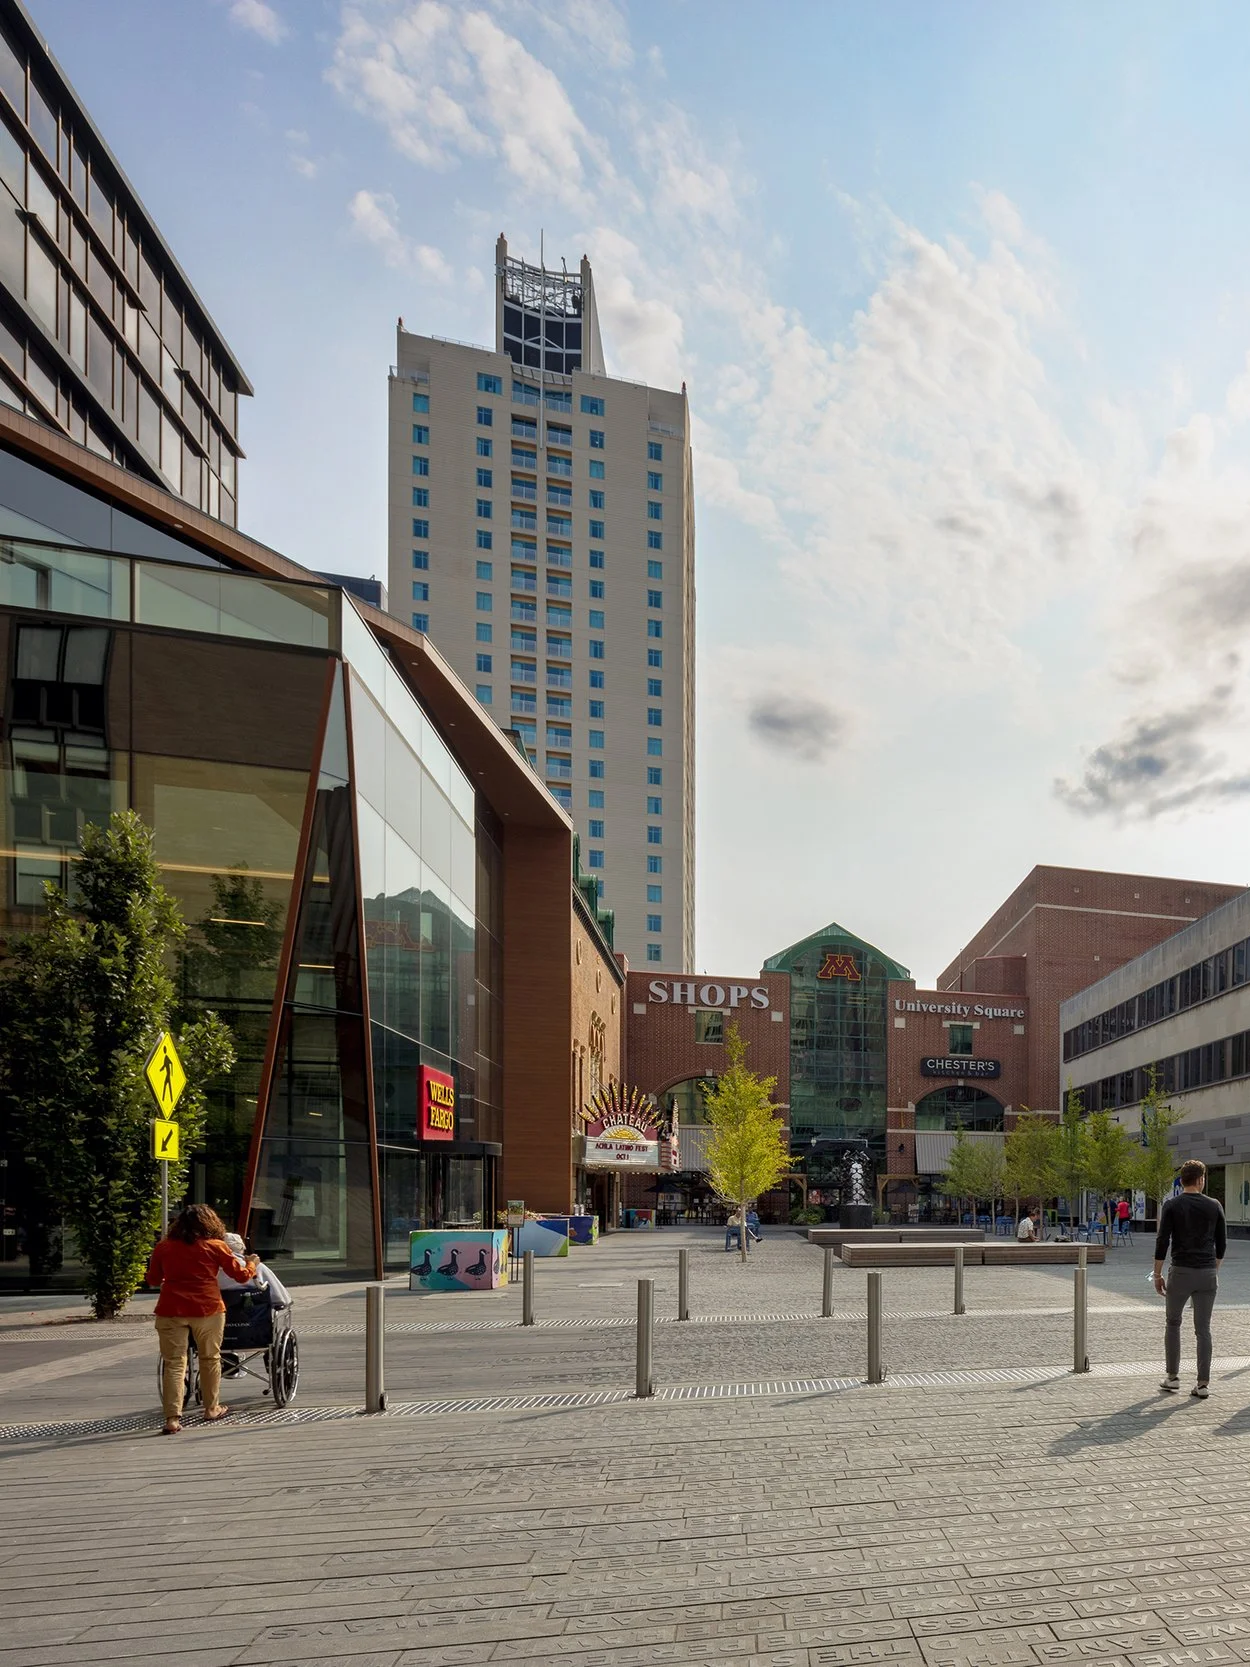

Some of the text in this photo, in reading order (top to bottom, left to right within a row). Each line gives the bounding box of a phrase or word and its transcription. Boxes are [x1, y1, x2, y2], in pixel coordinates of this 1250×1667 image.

[648, 979, 770, 1010] SHOPS
[895, 998, 1025, 1020] University Square
[926, 1058, 995, 1072] CHESTER'S
[430, 1080, 455, 1106] WELLS
[430, 1106, 455, 1131] FARGO
[602, 1113, 648, 1133] CHATEAU
[635, 1144, 649, 1152] FEST
[1106, 1519, 1226, 1533] WATER
[867, 1542, 944, 1555] FOR
[957, 1532, 1056, 1547] SONG
[1082, 1533, 1189, 1548] EVERY
[875, 1544, 1068, 1570] MEANDER
[973, 1542, 1217, 1573] WATERWAYS
[737, 1563, 873, 1581] EVERY
[964, 1573, 1046, 1589] AND
[1062, 1561, 1177, 1581] WAVE
[1139, 1572, 1214, 1587] THE
[576, 1569, 961, 1613] INTERCONNECTED
[870, 1583, 954, 1599] THE
[979, 1583, 1131, 1605] WATER
[1081, 1588, 1223, 1612] DREAM
[729, 1592, 854, 1614] SEA'S
[895, 1599, 969, 1615] WE
[575, 1609, 711, 1629] ROAR
[792, 1609, 873, 1625] ARE
[917, 1606, 1067, 1633] SONGS
[1061, 1614, 1150, 1633] AND
[684, 1620, 777, 1637] THE
[766, 1624, 902, 1647] COME
[927, 1627, 1047, 1651] HELD
[1041, 1633, 1167, 1659] SANG
[815, 1643, 913, 1664] THE
[1137, 1647, 1231, 1666] THE
